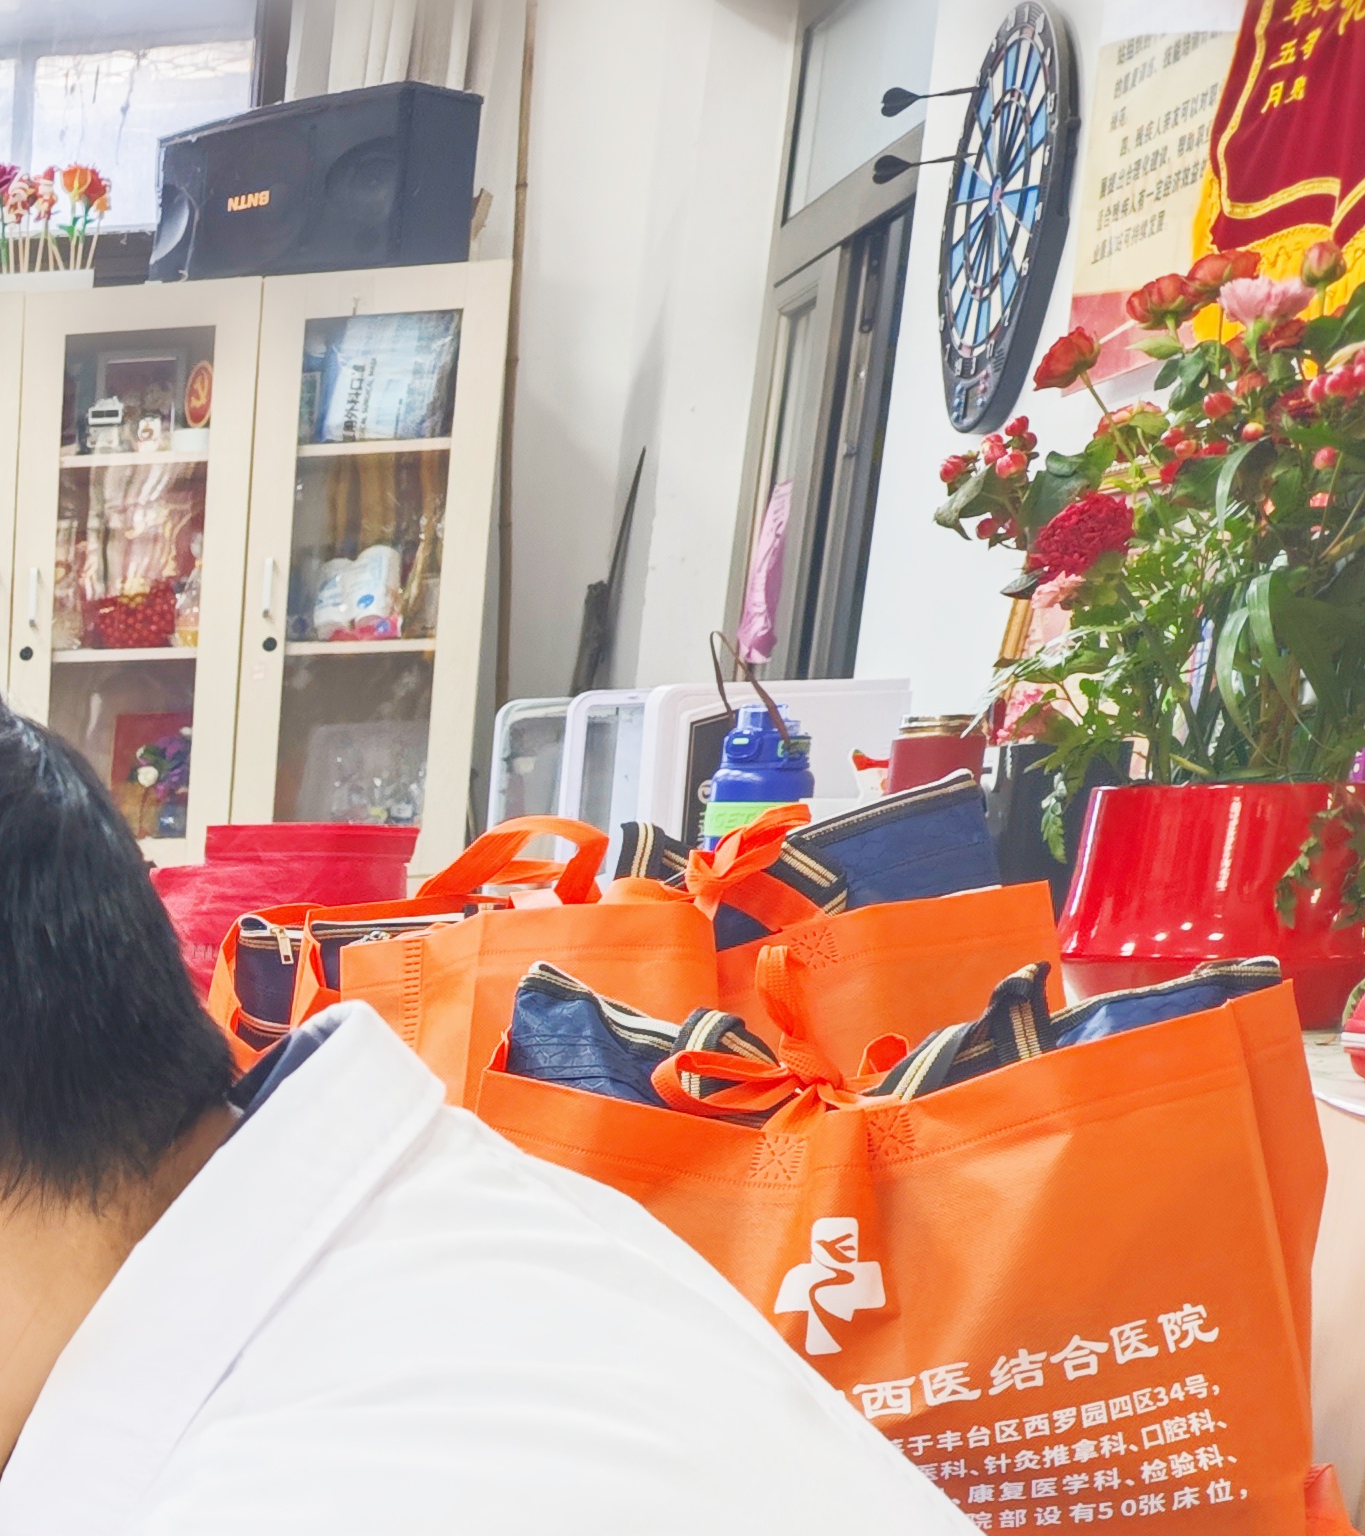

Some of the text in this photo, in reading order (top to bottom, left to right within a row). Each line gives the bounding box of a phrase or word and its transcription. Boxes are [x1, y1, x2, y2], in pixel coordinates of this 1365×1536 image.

[835, 1303, 1220, 1420] 西医结合医院
[939, 1444, 1238, 1506] 、康复医学科、检验科、
